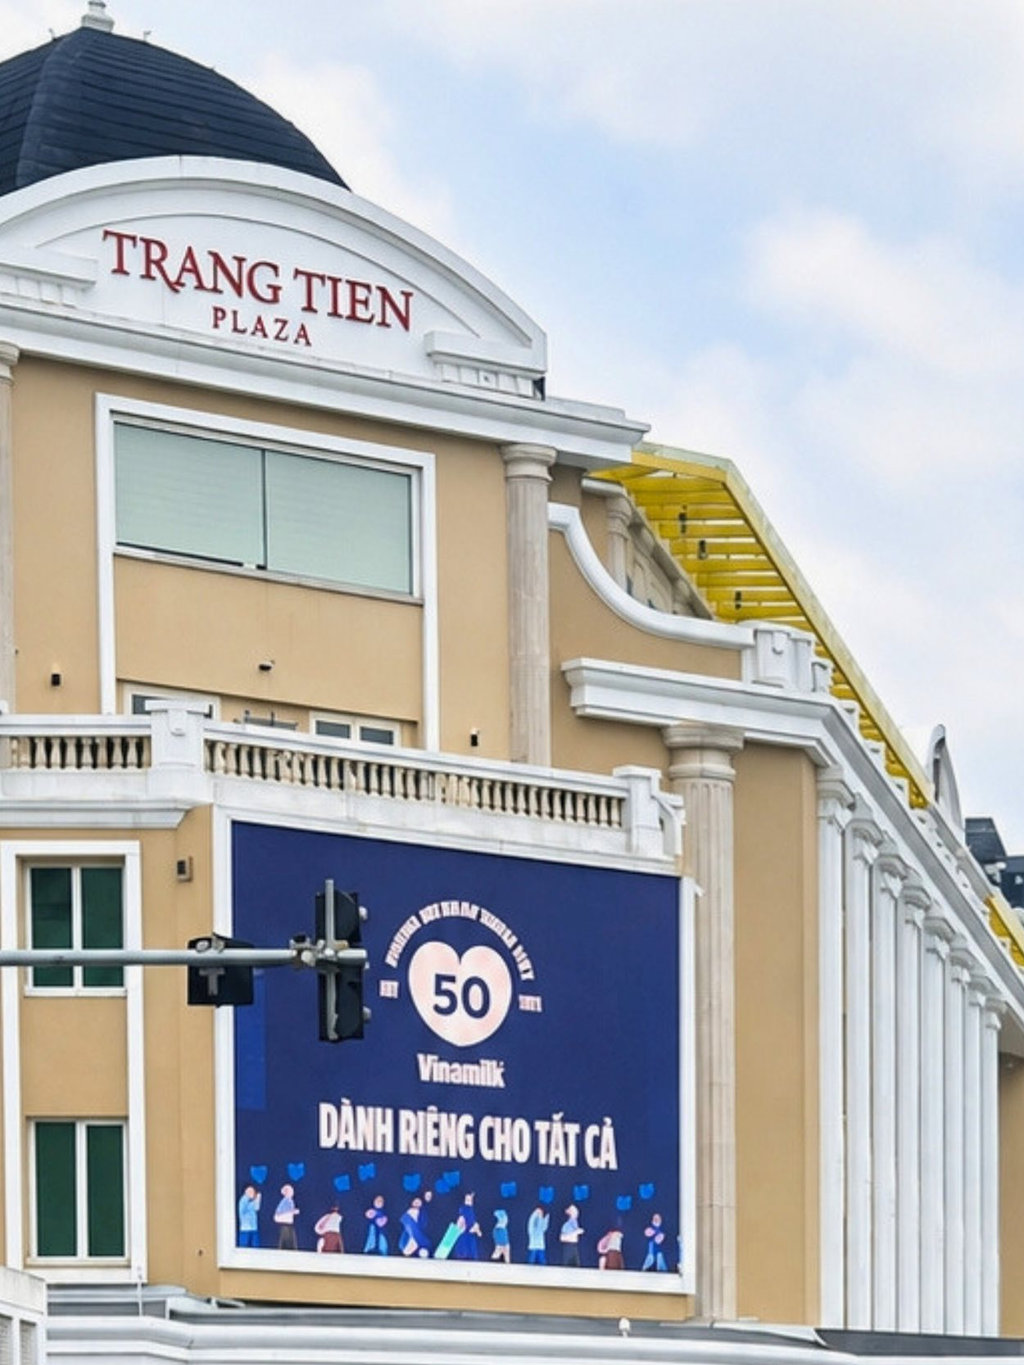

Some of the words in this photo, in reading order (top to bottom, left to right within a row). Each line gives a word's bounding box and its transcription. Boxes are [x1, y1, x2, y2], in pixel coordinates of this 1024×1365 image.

[103, 230, 282, 304] TRANG
[293, 268, 413, 331] TIEN
[212, 306, 311, 346] PLAZA
[433, 973, 490, 1019] 50
[417, 1053, 506, 1088] Vinamilk
[319, 1098, 394, 1153] DÀNH
[399, 1106, 474, 1160] RIÊNG
[479, 1115, 531, 1163] CHO
[585, 1117, 618, 1170] CẢ
